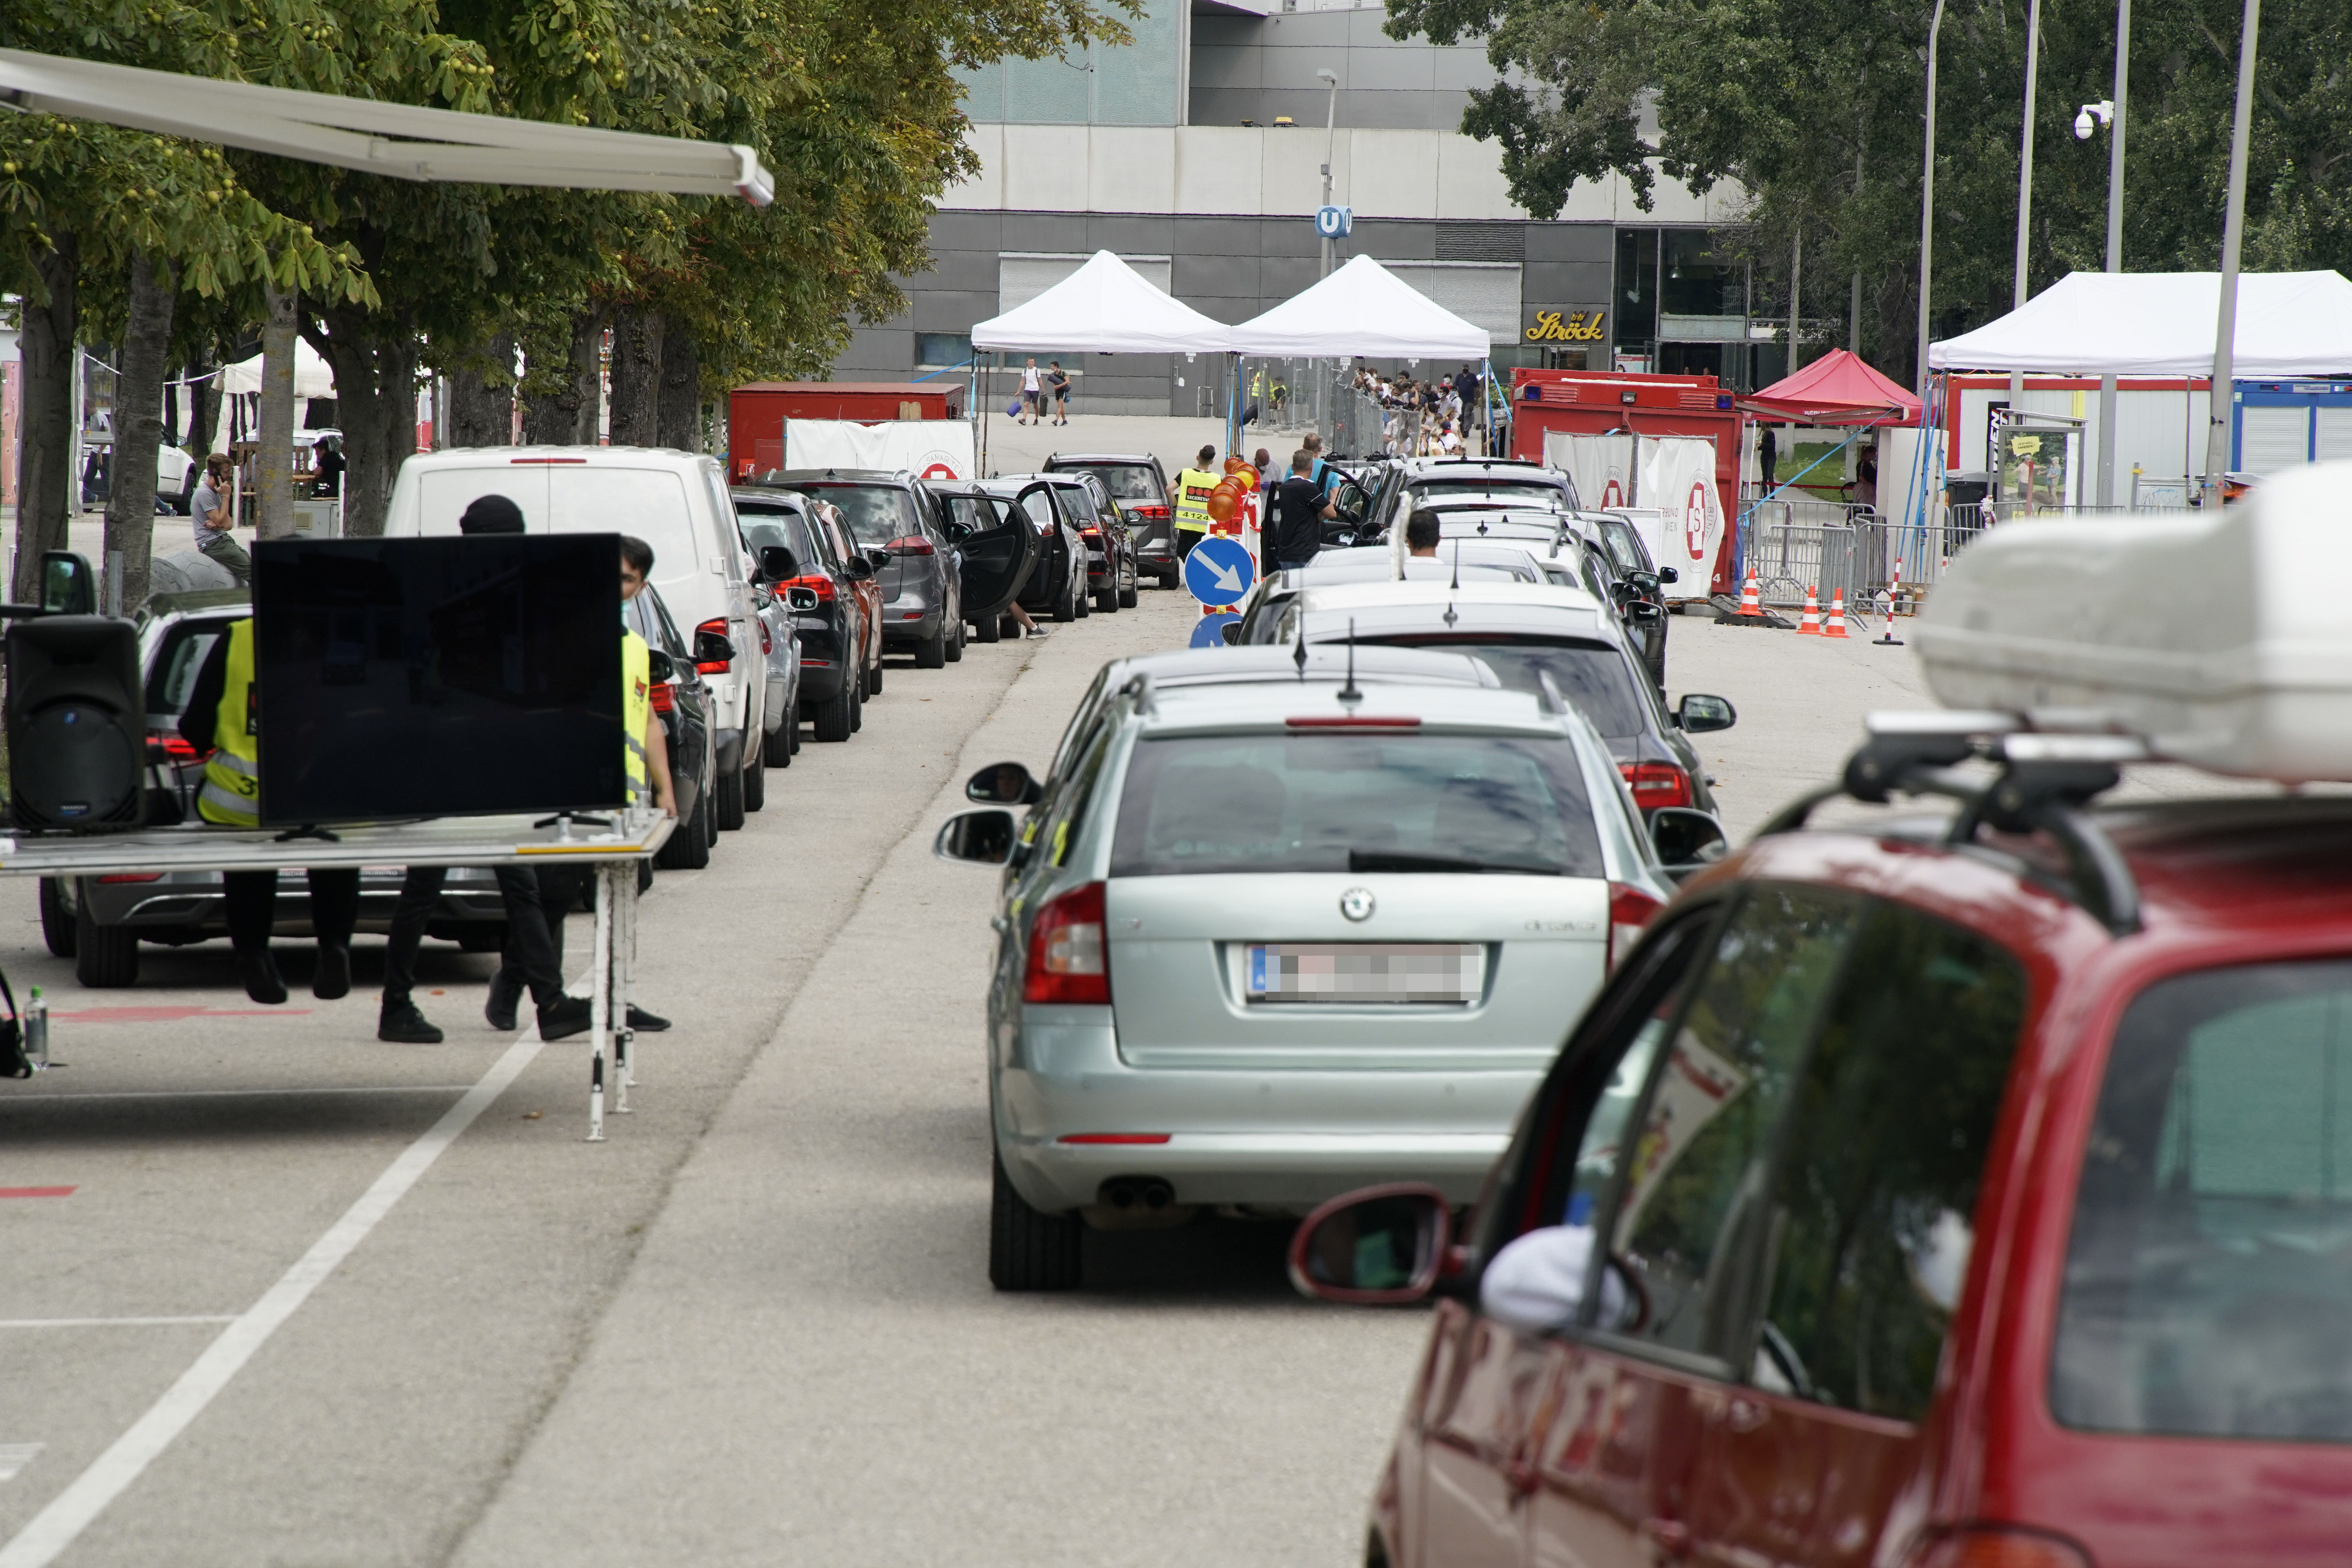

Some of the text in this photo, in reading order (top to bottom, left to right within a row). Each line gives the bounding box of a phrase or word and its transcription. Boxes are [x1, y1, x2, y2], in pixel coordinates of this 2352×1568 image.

[1321, 212, 1339, 233] U
[1526, 310, 1604, 341] Ströck
[1182, 511, 1210, 521] 4124
[1712, 573, 1721, 583] 4
